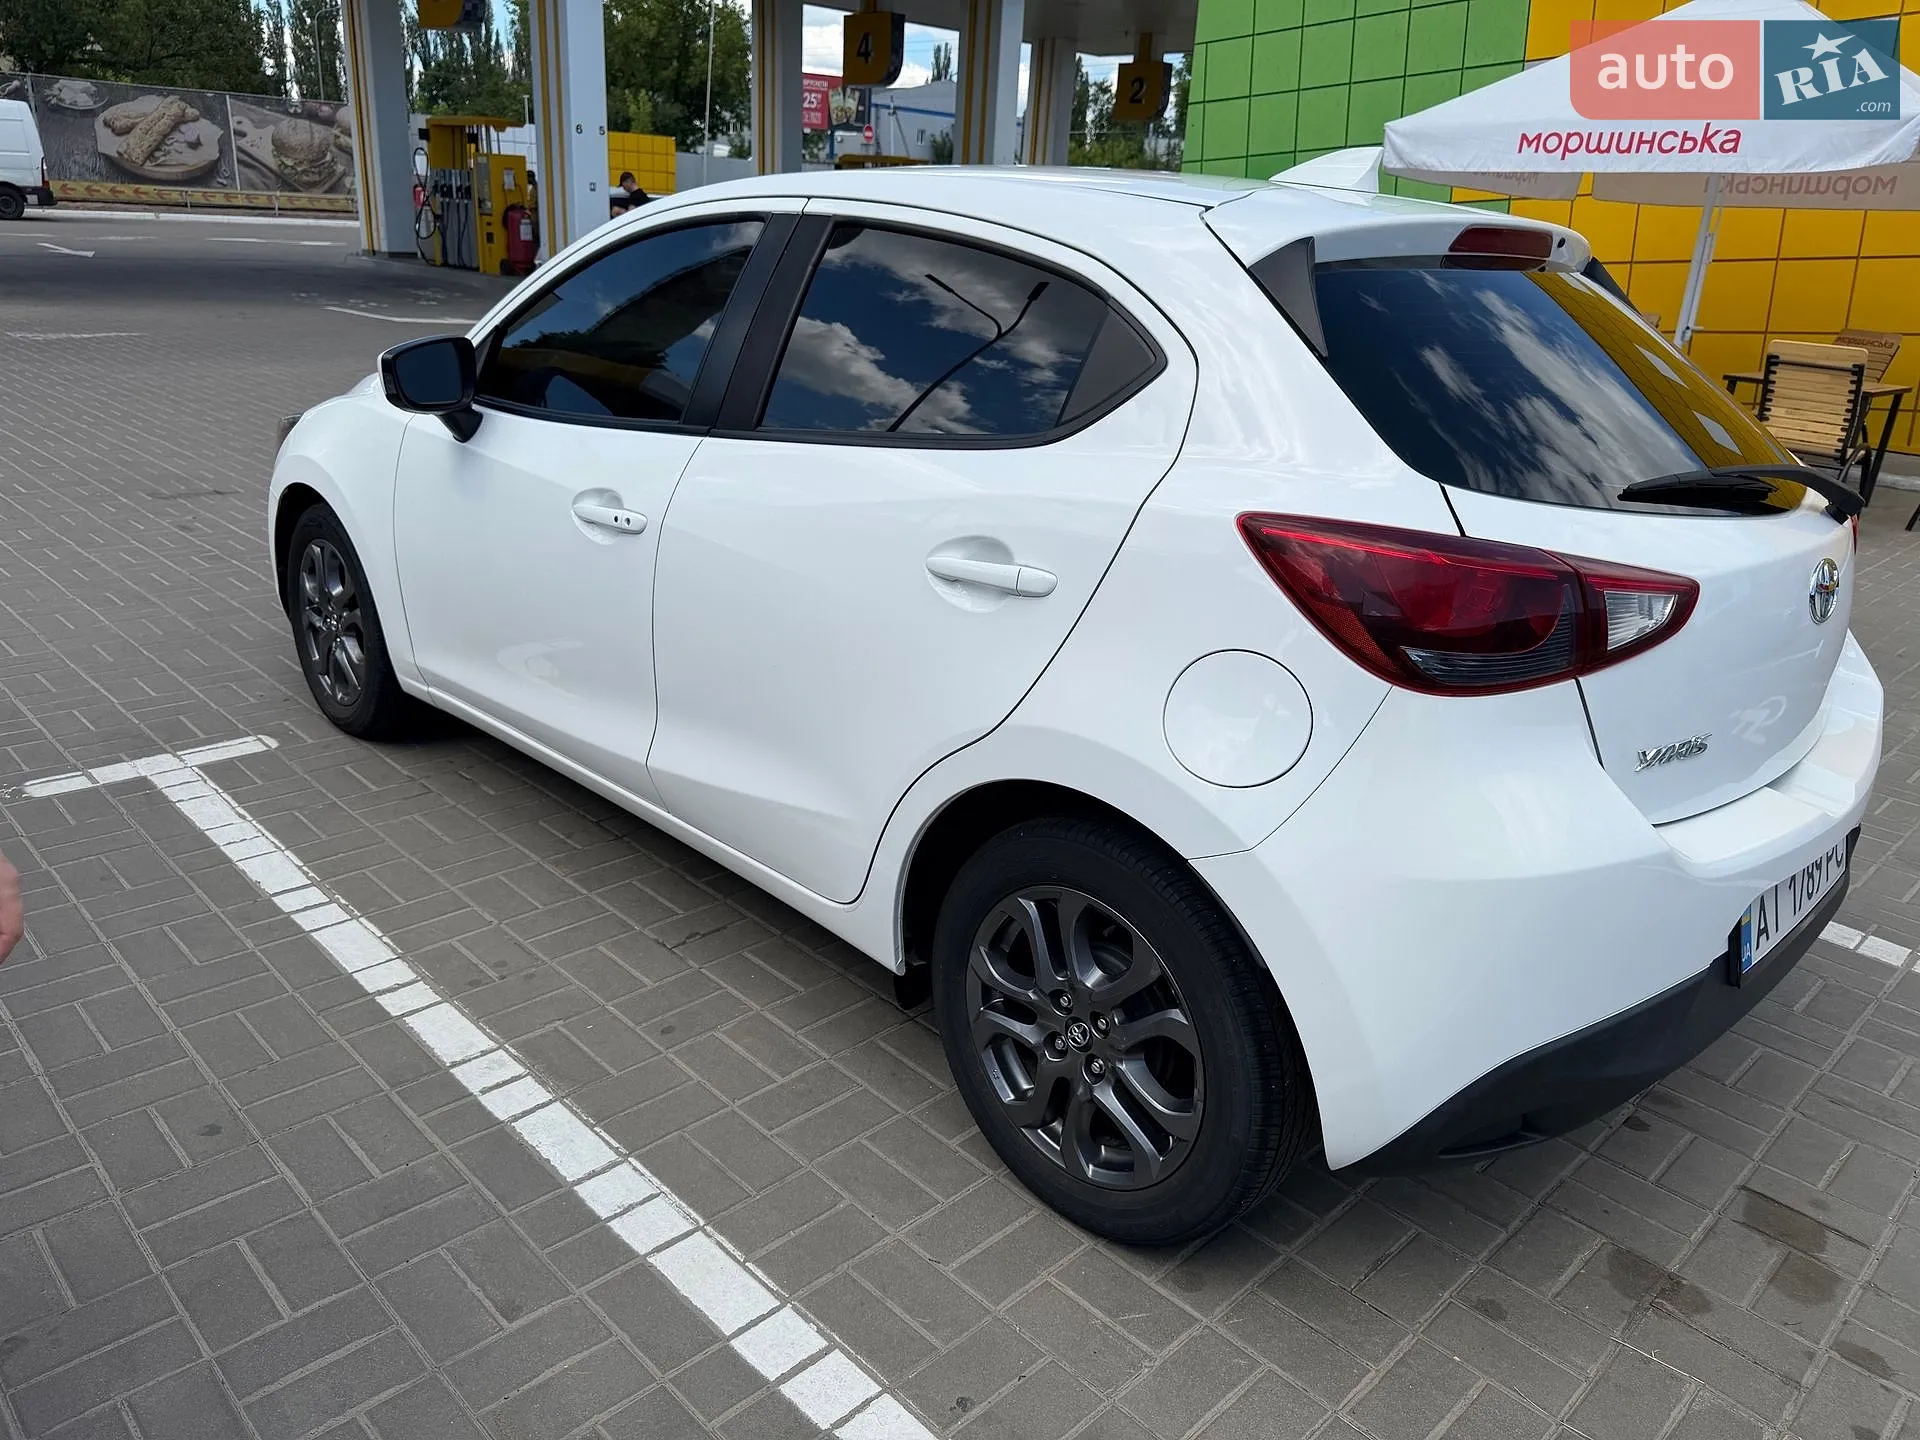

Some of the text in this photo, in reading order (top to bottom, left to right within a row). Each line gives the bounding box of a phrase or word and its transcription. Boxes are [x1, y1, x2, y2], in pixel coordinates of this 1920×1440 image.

[856, 31, 873, 64] 4
[803, 92, 817, 108] 25
[1129, 76, 1145, 104] 2
[576, 124, 583, 134] 6
[599, 126, 605, 135] 5
[1517, 122, 1742, 160] моршинська
[1634, 733, 1712, 772] YARIS
[1742, 942, 1751, 962] UA
